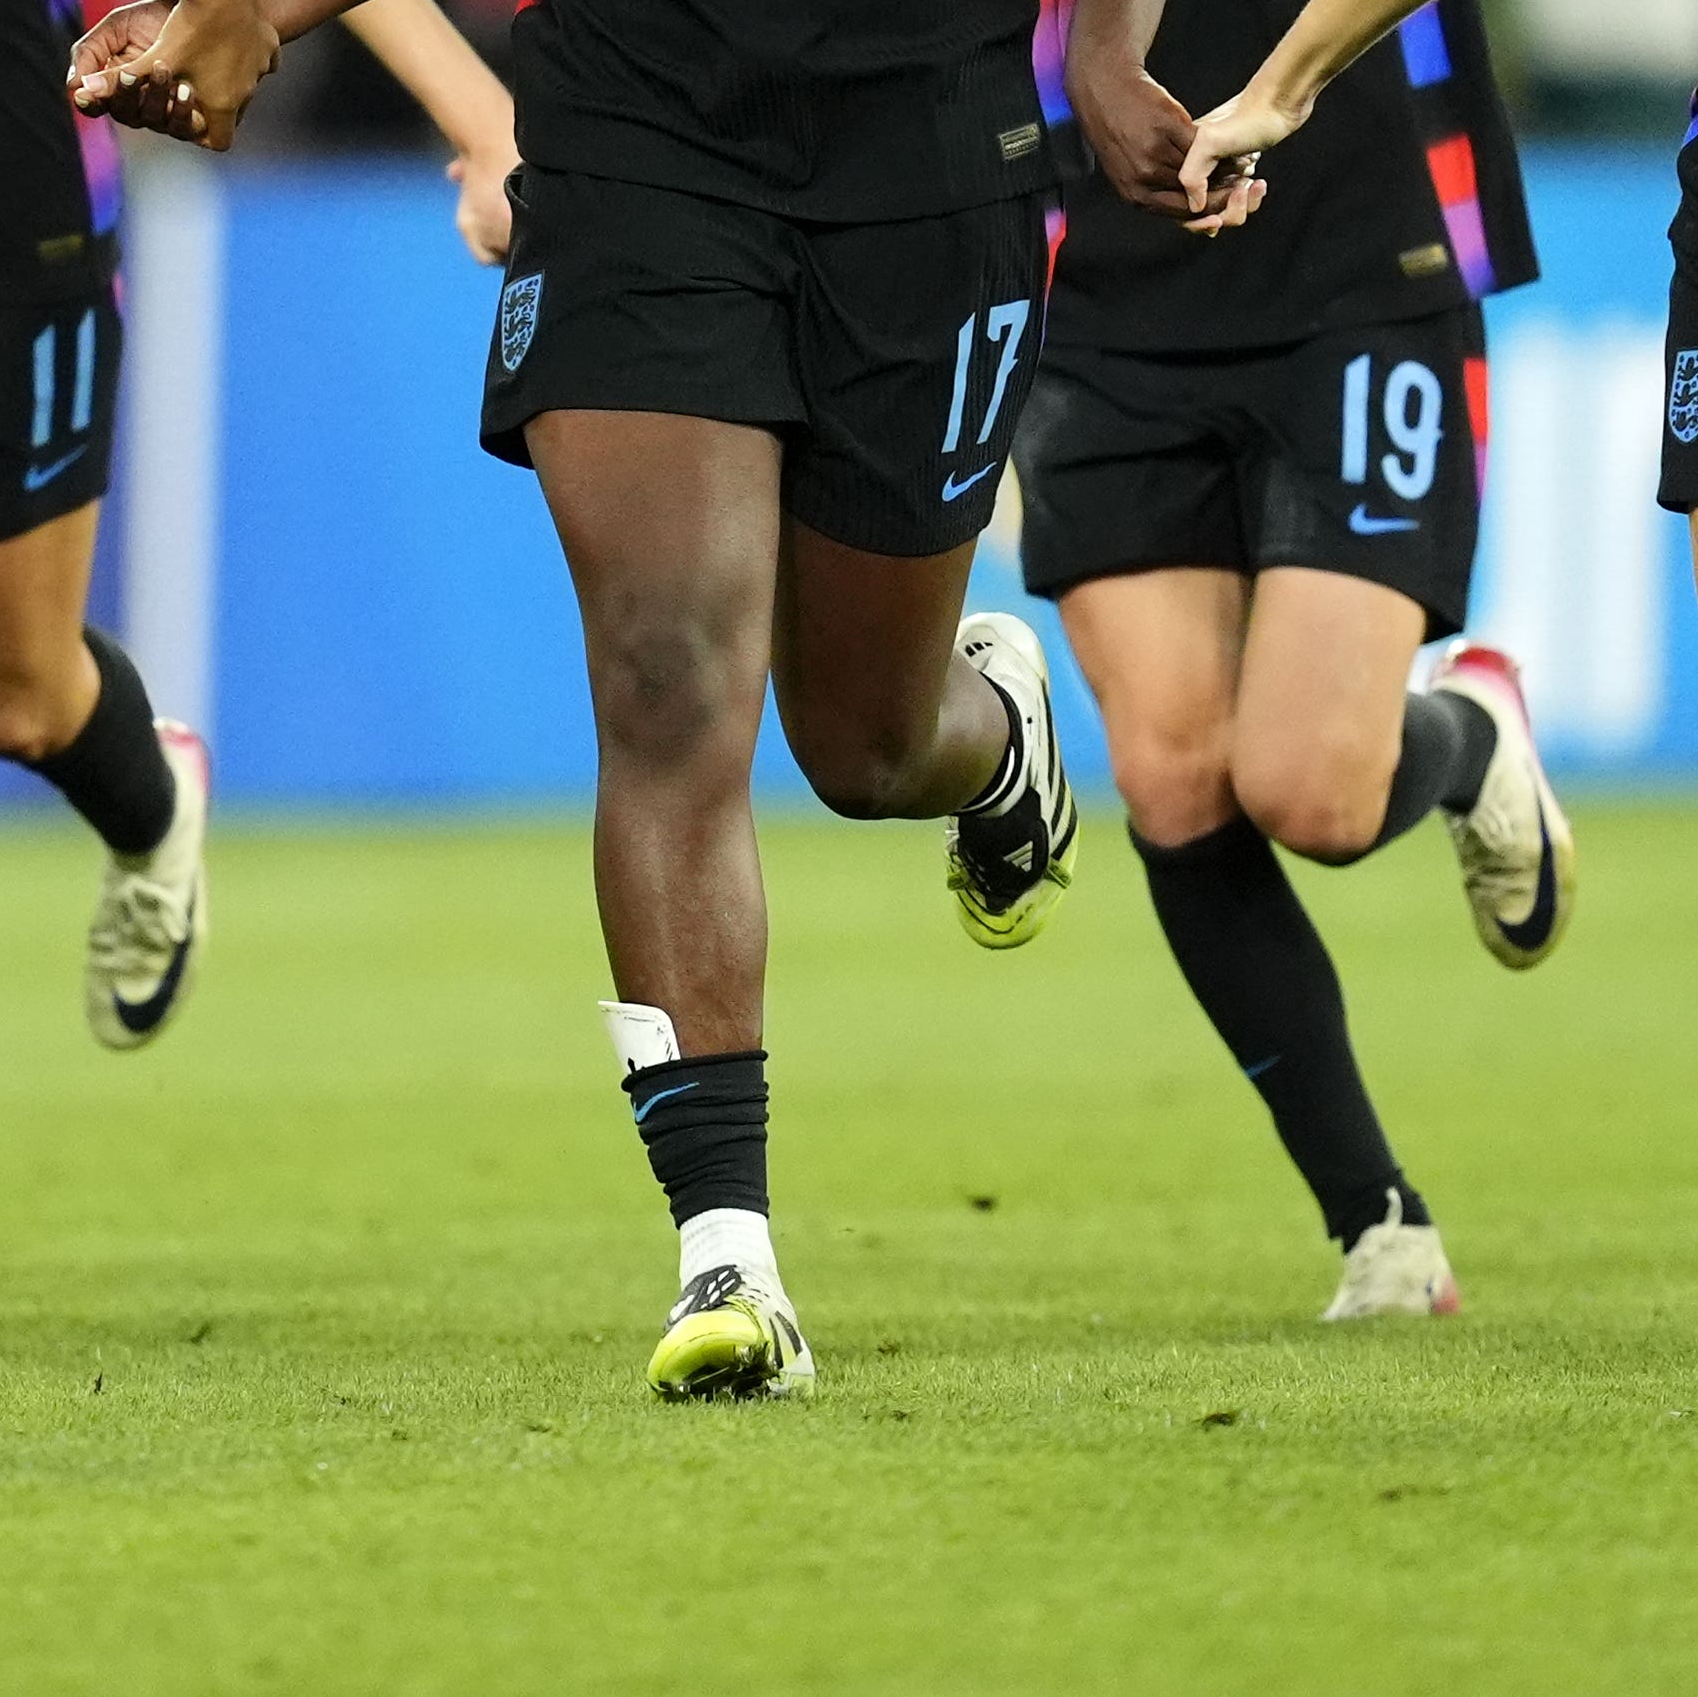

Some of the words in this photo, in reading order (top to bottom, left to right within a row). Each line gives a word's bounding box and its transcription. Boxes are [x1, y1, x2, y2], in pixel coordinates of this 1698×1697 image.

[30, 307, 96, 447] 11
[941, 300, 1030, 454] 17
[1340, 352, 1445, 500] 19
